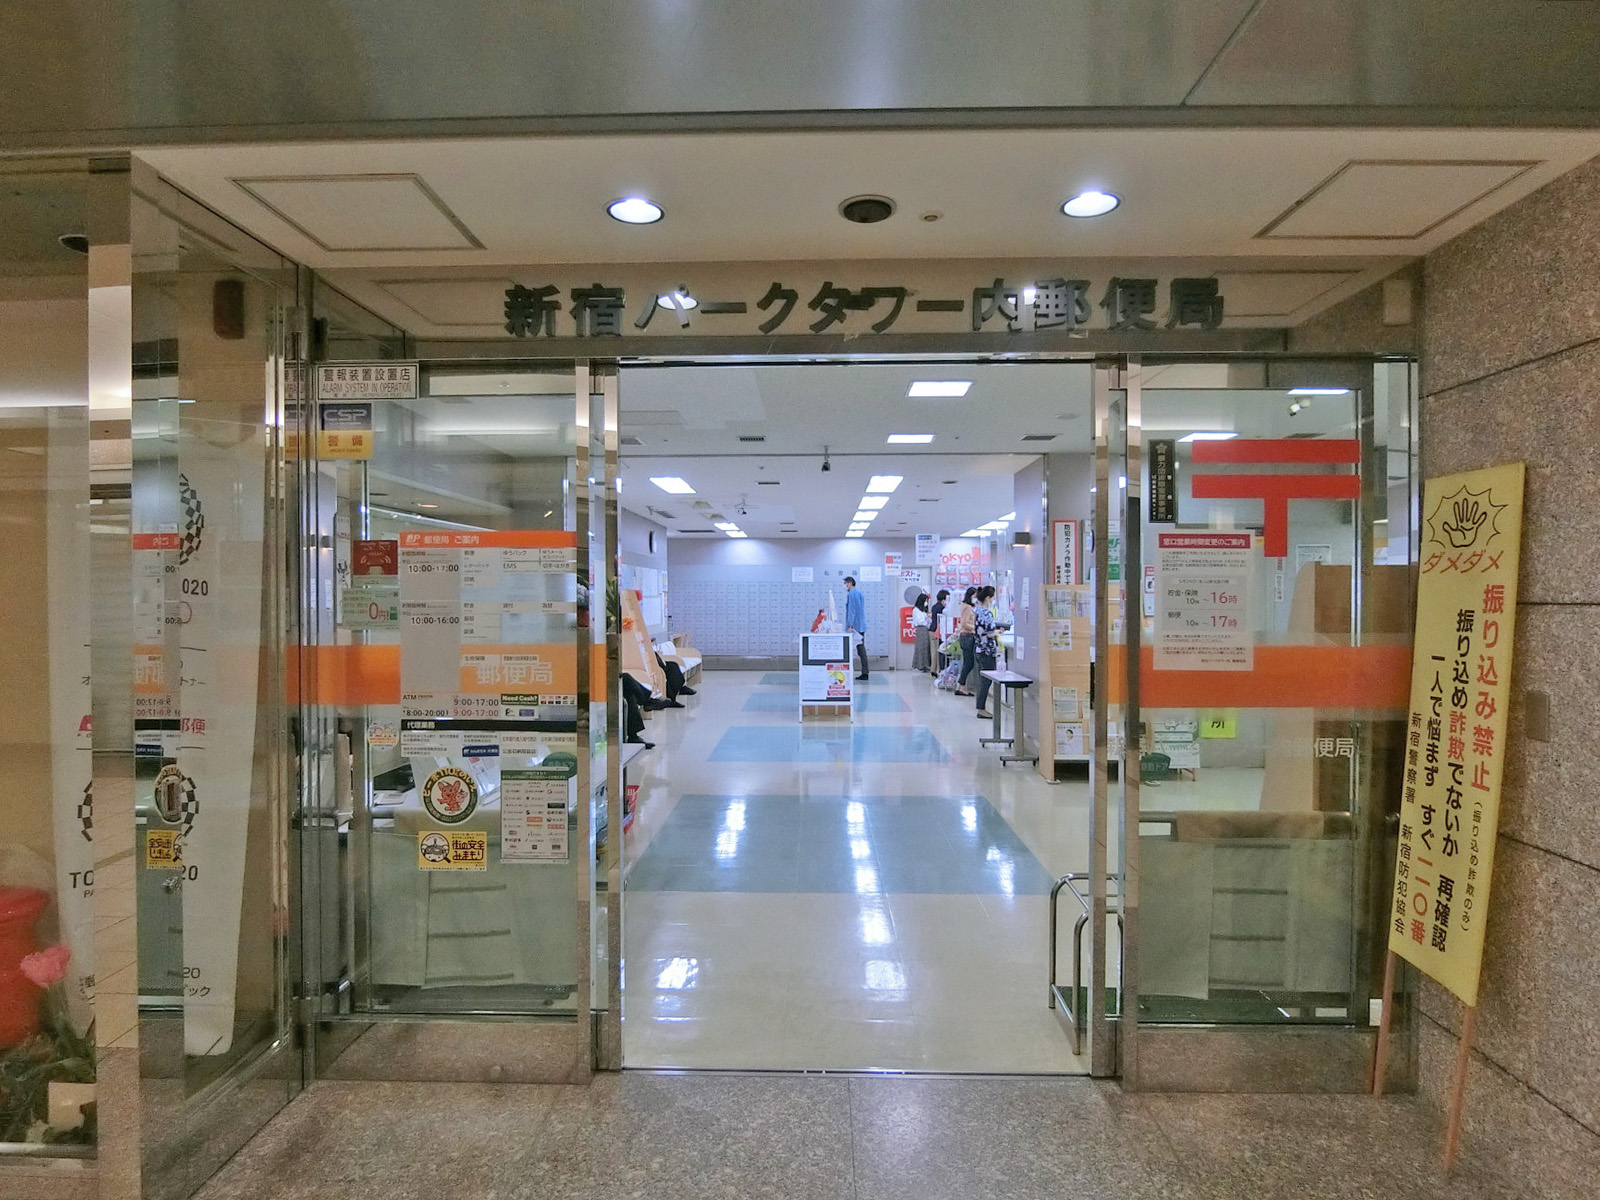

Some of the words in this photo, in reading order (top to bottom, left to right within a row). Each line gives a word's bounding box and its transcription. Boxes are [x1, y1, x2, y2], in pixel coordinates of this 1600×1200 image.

[503, 277, 1224, 337] 新宿パークタワー内郵便局
[324, 368, 411, 381] 警報装置設置店
[322, 382, 342, 393] ALARM
[344, 382, 369, 393] SYSTEM
[371, 382, 378, 393] IN
[380, 382, 411, 393] OPERATION
[503, 562, 517, 570] EMS
[1421, 550, 1505, 575] ダメダメ
[411, 616, 460, 625] 10:00-16:00
[477, 661, 553, 685] 郵便局
[502, 694, 518, 702] Need
[519, 694, 538, 702] Cash?
[1471, 583, 1505, 793] 振り込み禁止
[453, 698, 499, 707] 9:00-17:00
[453, 709, 499, 717] 9:00-17:00
[1424, 654, 1446, 787] 一人で悩まず
[1441, 608, 1475, 858] 振り込め詐欺でないか
[1404, 712, 1422, 804] 新宿警察署
[452, 850, 485, 861] みまもり
[1393, 823, 1413, 936] 新宿防犯協会
[1431, 874, 1455, 953] 再確認
